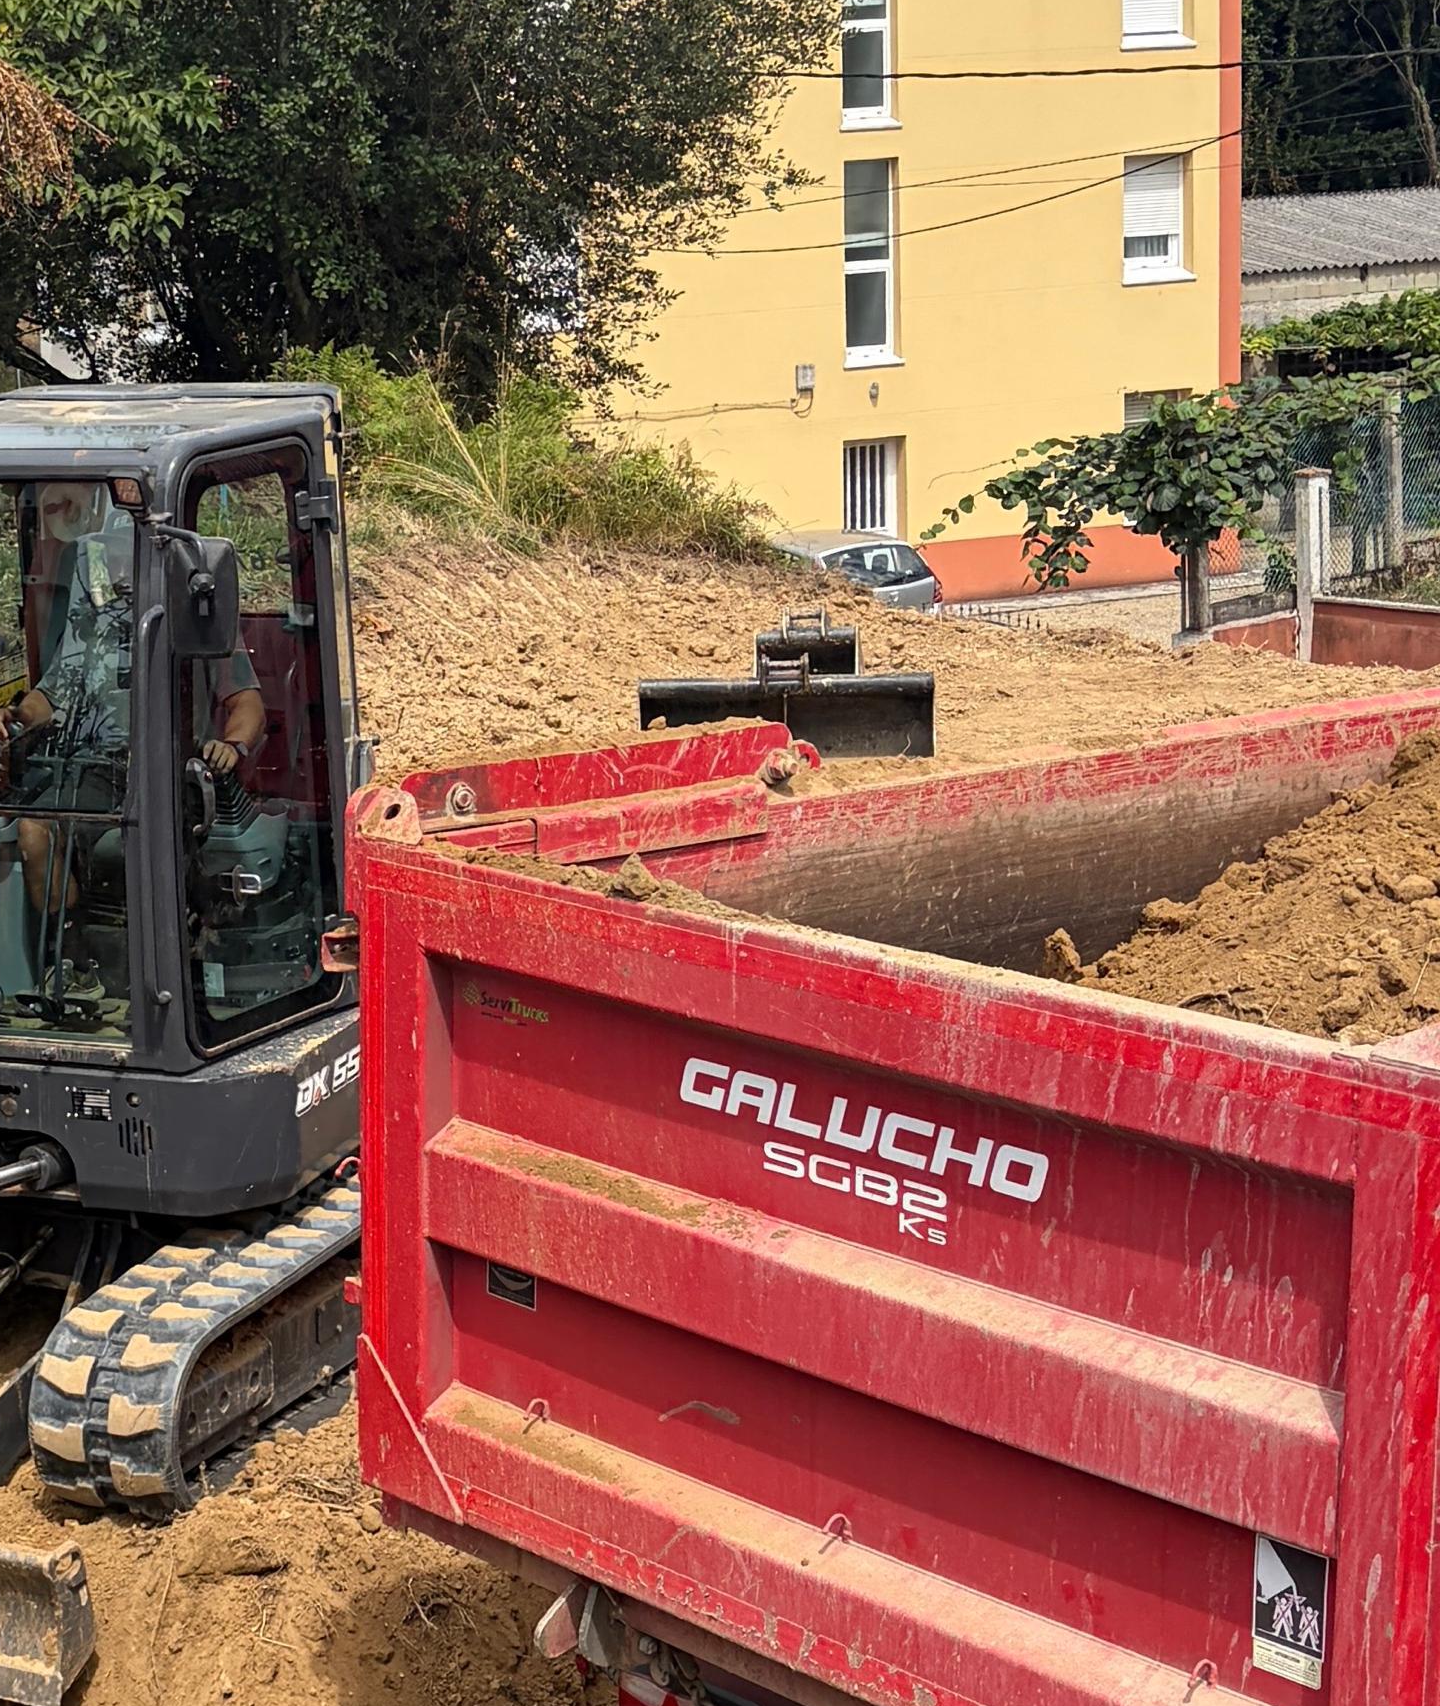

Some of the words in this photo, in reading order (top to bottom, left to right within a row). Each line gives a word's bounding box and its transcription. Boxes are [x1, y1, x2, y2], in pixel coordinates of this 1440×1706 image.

[295, 1065, 331, 1117] DX
[680, 1057, 1050, 1203] GALUCHO
[763, 1141, 948, 1223] SGB2
